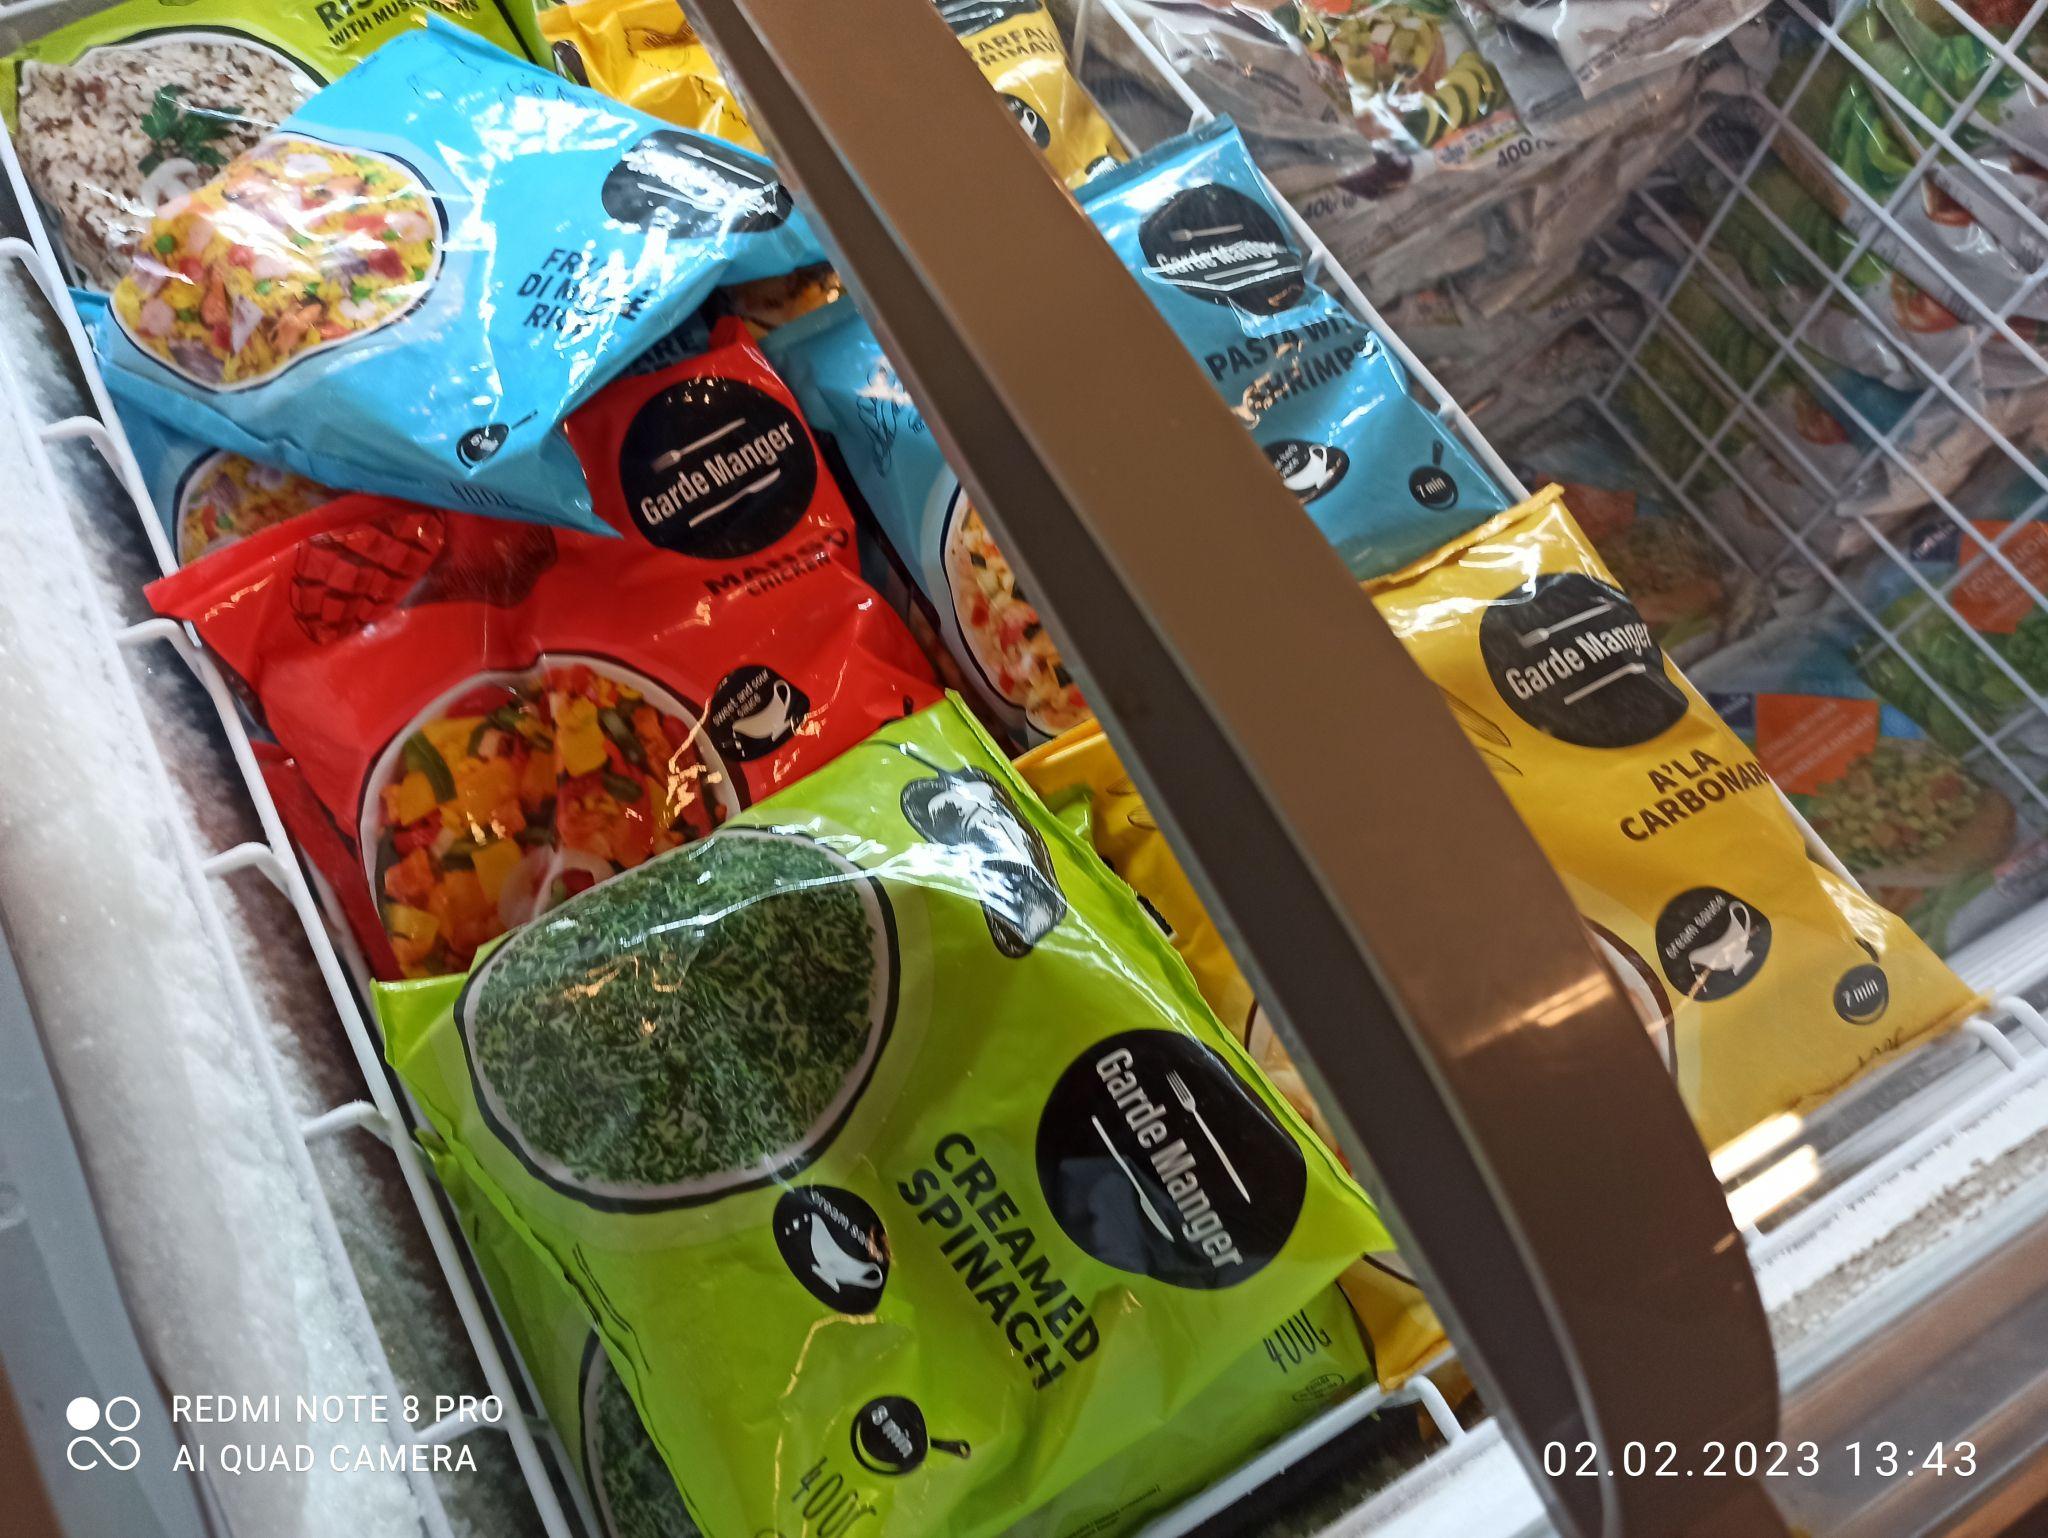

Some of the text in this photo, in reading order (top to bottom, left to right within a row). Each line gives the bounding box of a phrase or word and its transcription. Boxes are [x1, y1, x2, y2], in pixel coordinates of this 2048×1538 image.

[329, 17, 373, 46] WITH
[640, 418, 794, 527] Garde Manger
[735, 681, 756, 706] and
[1504, 620, 1653, 702] Garde Manger
[1620, 758, 1771, 842] CARBONAR
[1853, 979, 1879, 1003] min
[1094, 1048, 1244, 1271] Garde Manger
[810, 1189, 850, 1231] cream
[933, 1132, 1100, 1363] CREAMED
[896, 1169, 1065, 1389] SPINACH
[870, 1404, 913, 1458] 8 min
